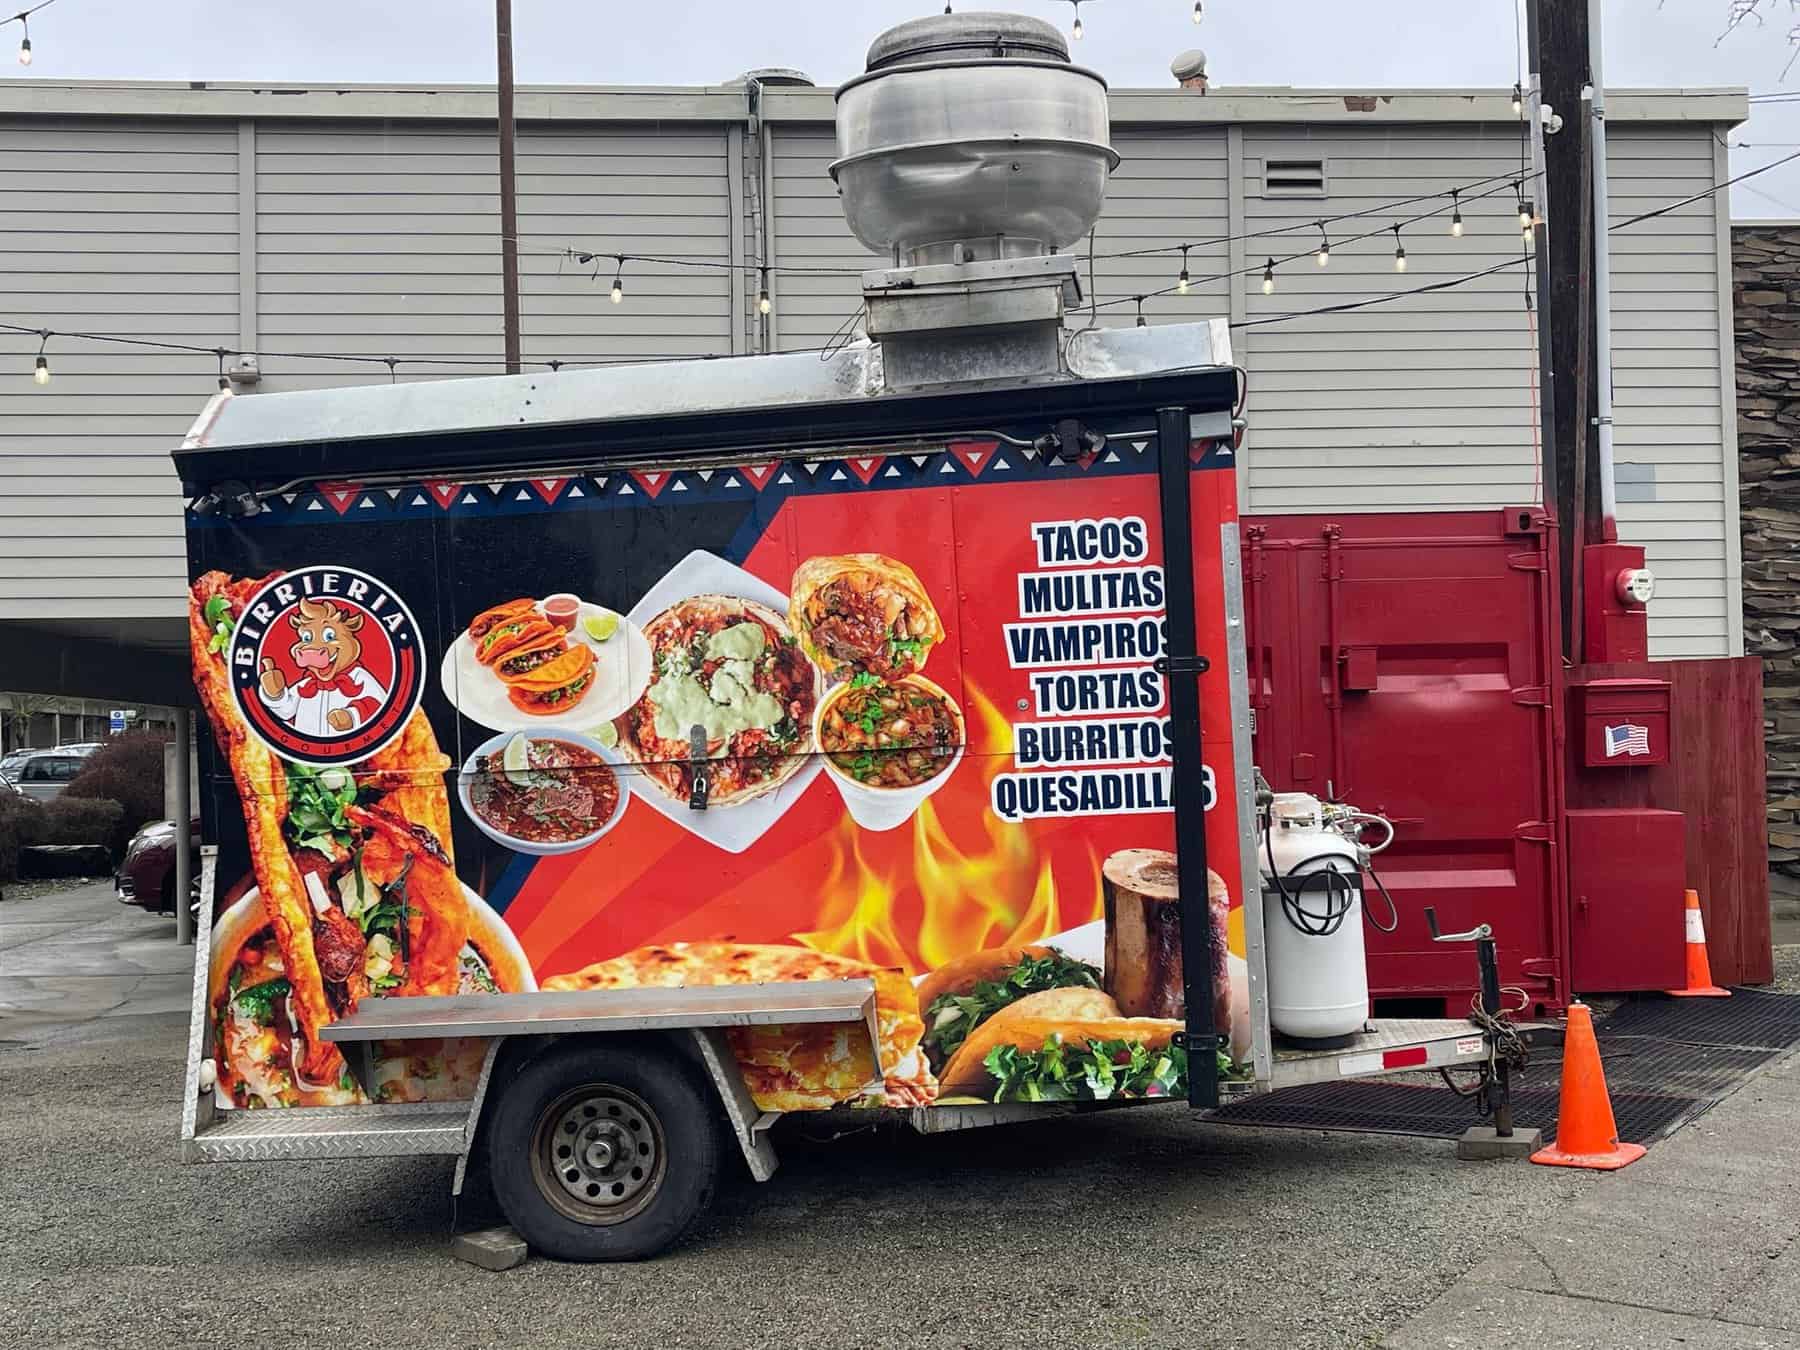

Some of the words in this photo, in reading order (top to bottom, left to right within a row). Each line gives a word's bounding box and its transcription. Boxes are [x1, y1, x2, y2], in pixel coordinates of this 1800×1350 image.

[1037, 521, 1143, 562] TACOS
[1023, 570, 1163, 613] MULITAS
[235, 573, 407, 666] BIRRIERIA
[1035, 672, 1160, 712] TORTAS
[280, 706, 400, 754] GOURMET
[996, 769, 1212, 818] QUESADILL
